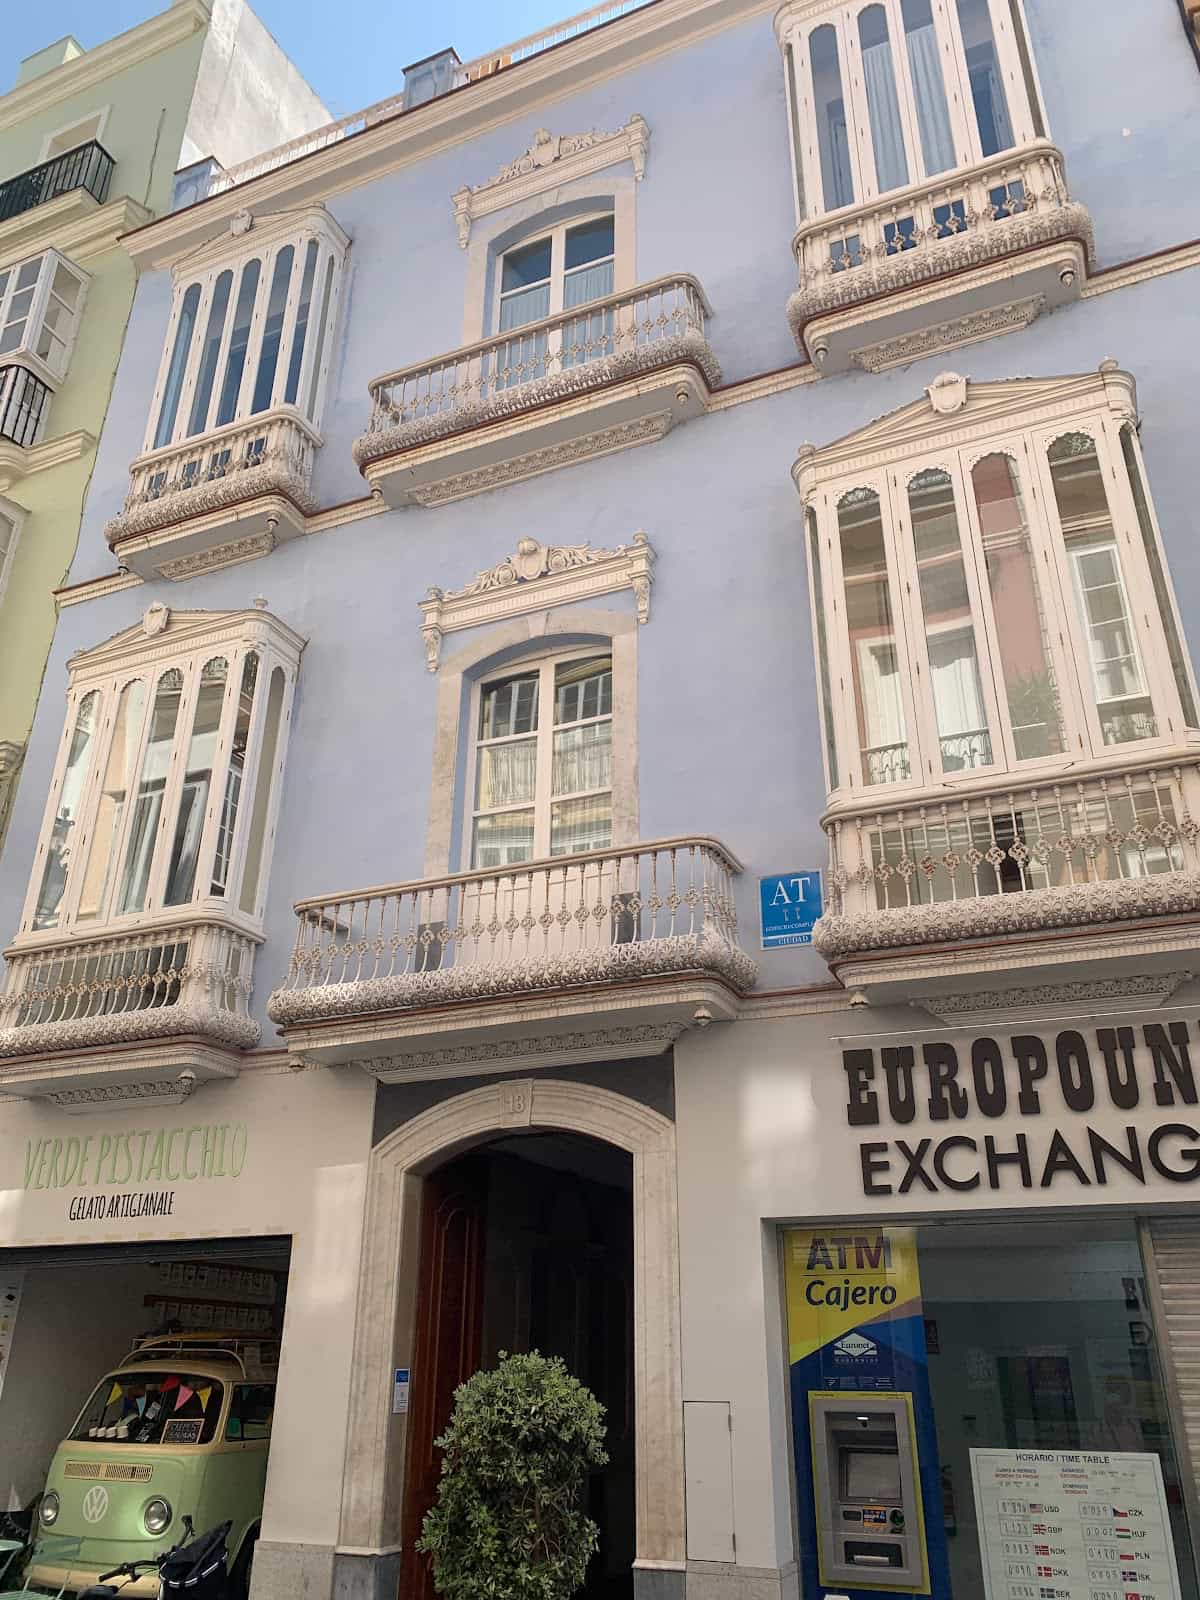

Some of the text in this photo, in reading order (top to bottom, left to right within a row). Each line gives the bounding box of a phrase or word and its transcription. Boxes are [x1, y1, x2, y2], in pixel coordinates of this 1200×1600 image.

[769, 876, 811, 906] AT
[778, 935, 809, 945] CIUDAD
[842, 1019, 1200, 1126] EUROPOUN
[23, 1120, 248, 1191] VERDE PISTACCHIO
[69, 1191, 175, 1221] GELATO ARTIGIANALE
[806, 1235, 893, 1270] ATM
[805, 1279, 897, 1311] Cajero
[1016, 1454, 1054, 1462] HORARIO
[1060, 1455, 1080, 1463] TIME
[1082, 1456, 1110, 1464] TABLE
